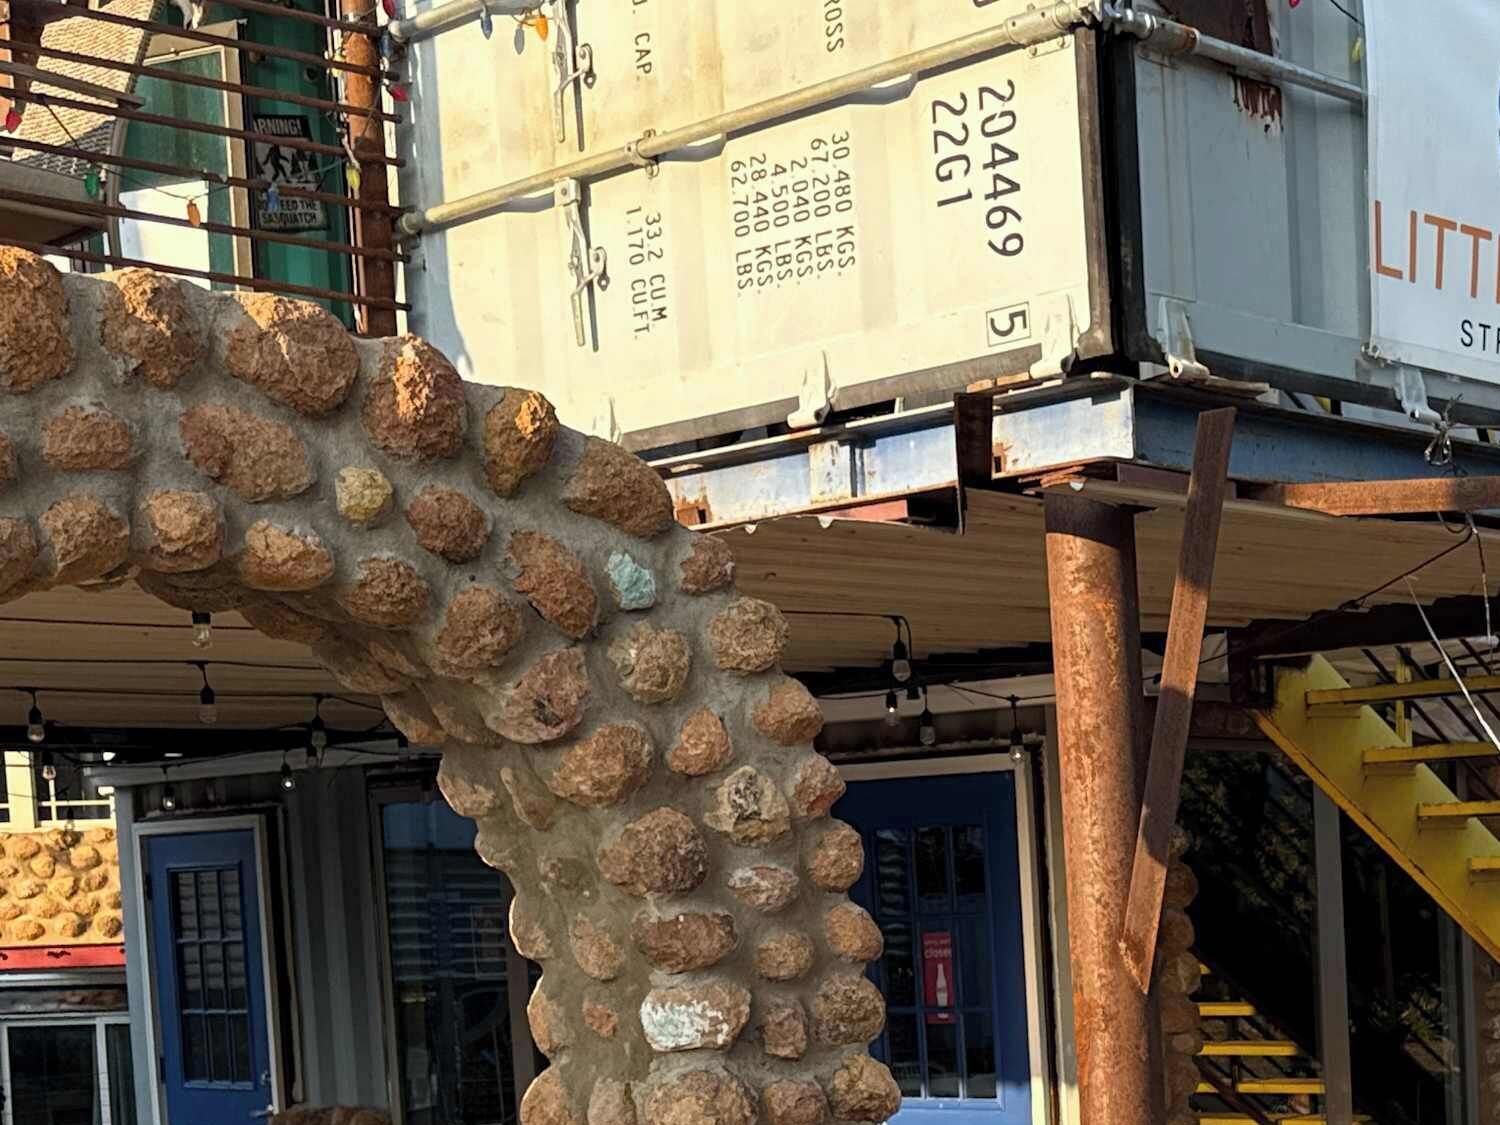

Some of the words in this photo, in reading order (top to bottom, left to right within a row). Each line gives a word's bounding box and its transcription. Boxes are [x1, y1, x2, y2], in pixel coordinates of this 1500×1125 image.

[810, 138, 831, 218] 67.200
[832, 131, 853, 213] 30.480
[932, 92, 973, 208] 22G1
[978, 79, 1024, 257] 204469
[730, 160, 751, 238] 62.700
[750, 153, 770, 233] 28.440
[771, 163, 790, 228] 4.500
[790, 157, 810, 223] 2.040
[626, 206, 645, 266] 1.170
[645, 212, 664, 262] 33.2
[774, 240, 793, 289] LBS.
[794, 235, 814, 286] KGS.
[815, 230, 834, 280] LBS.
[836, 225, 856, 277] KGS.
[735, 250, 754, 298] LBS.
[755, 245, 774, 295] KGS.
[990, 309, 1027, 337] 5
